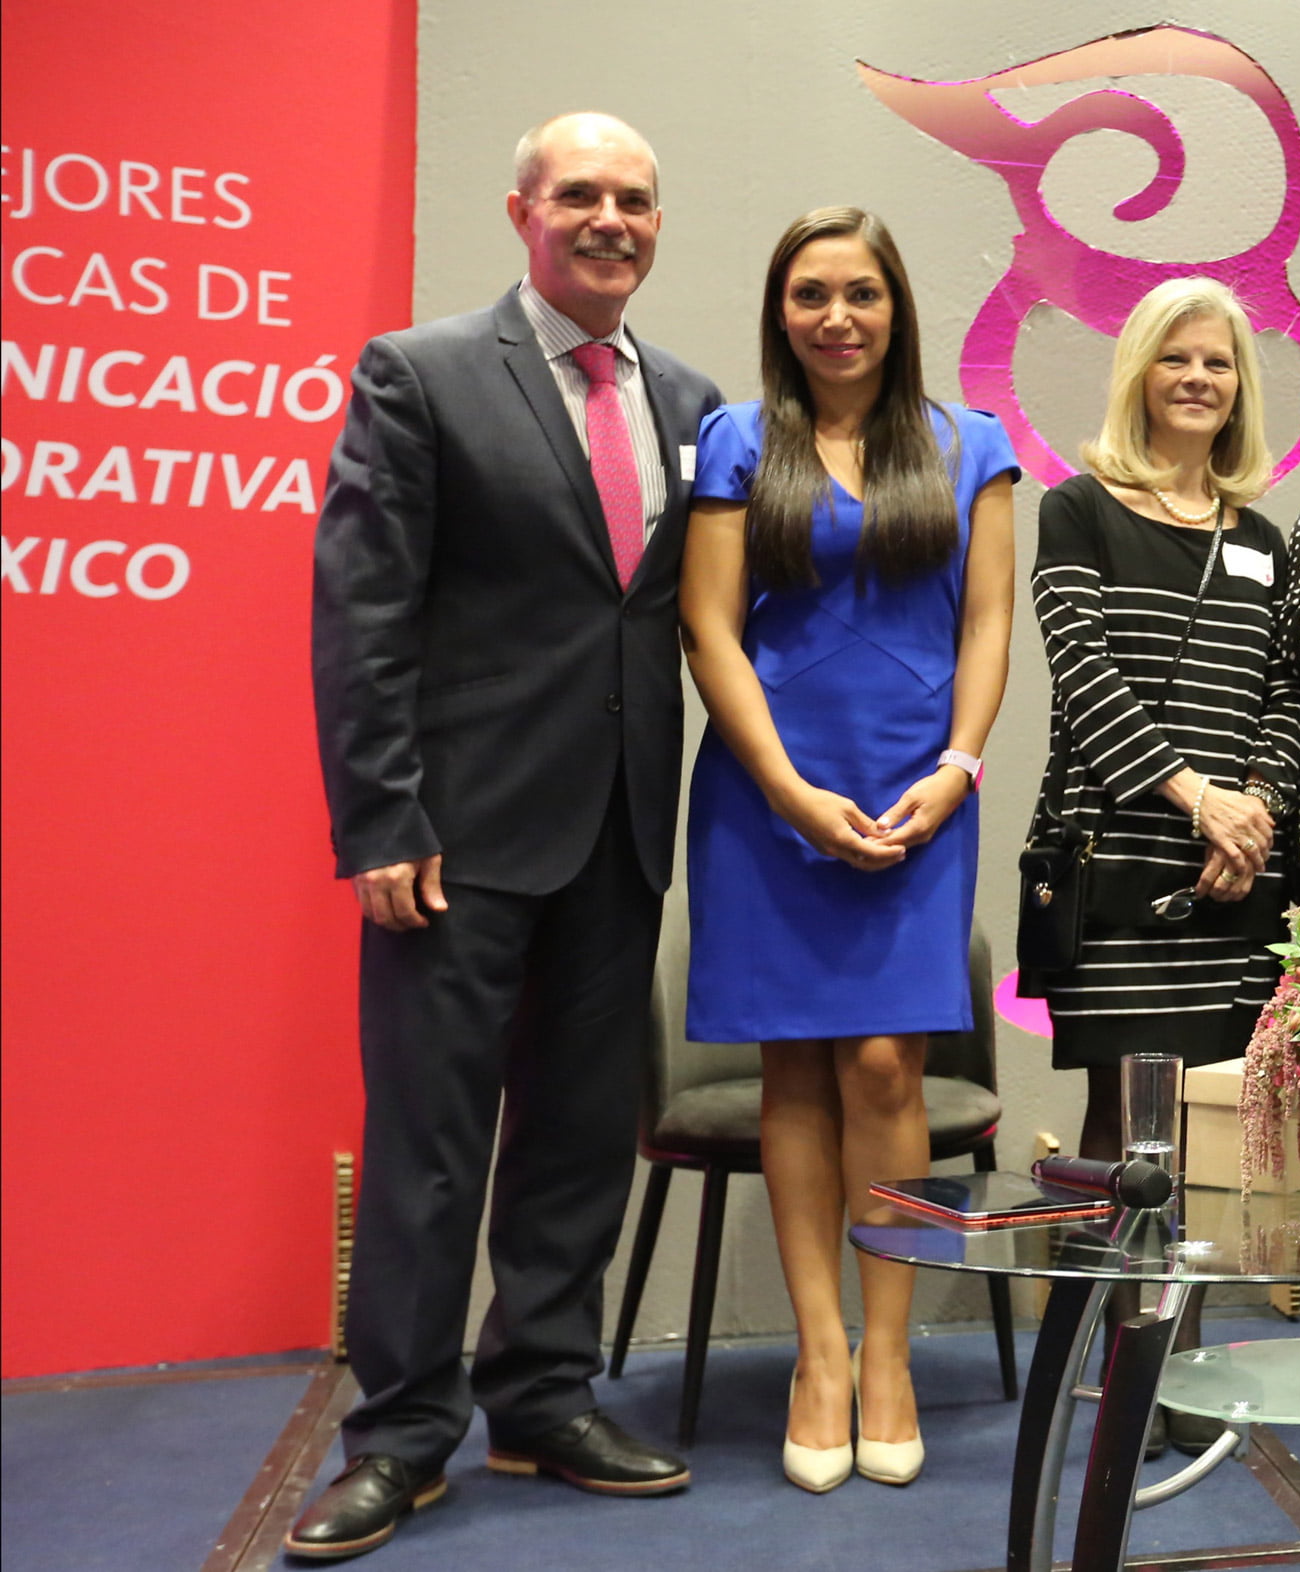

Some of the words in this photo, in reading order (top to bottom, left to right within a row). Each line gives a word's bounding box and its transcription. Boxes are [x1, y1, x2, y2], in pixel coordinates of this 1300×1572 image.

[1, 145, 252, 229] JORES
[11, 246, 169, 315] CAS
[198, 264, 292, 327] DE
